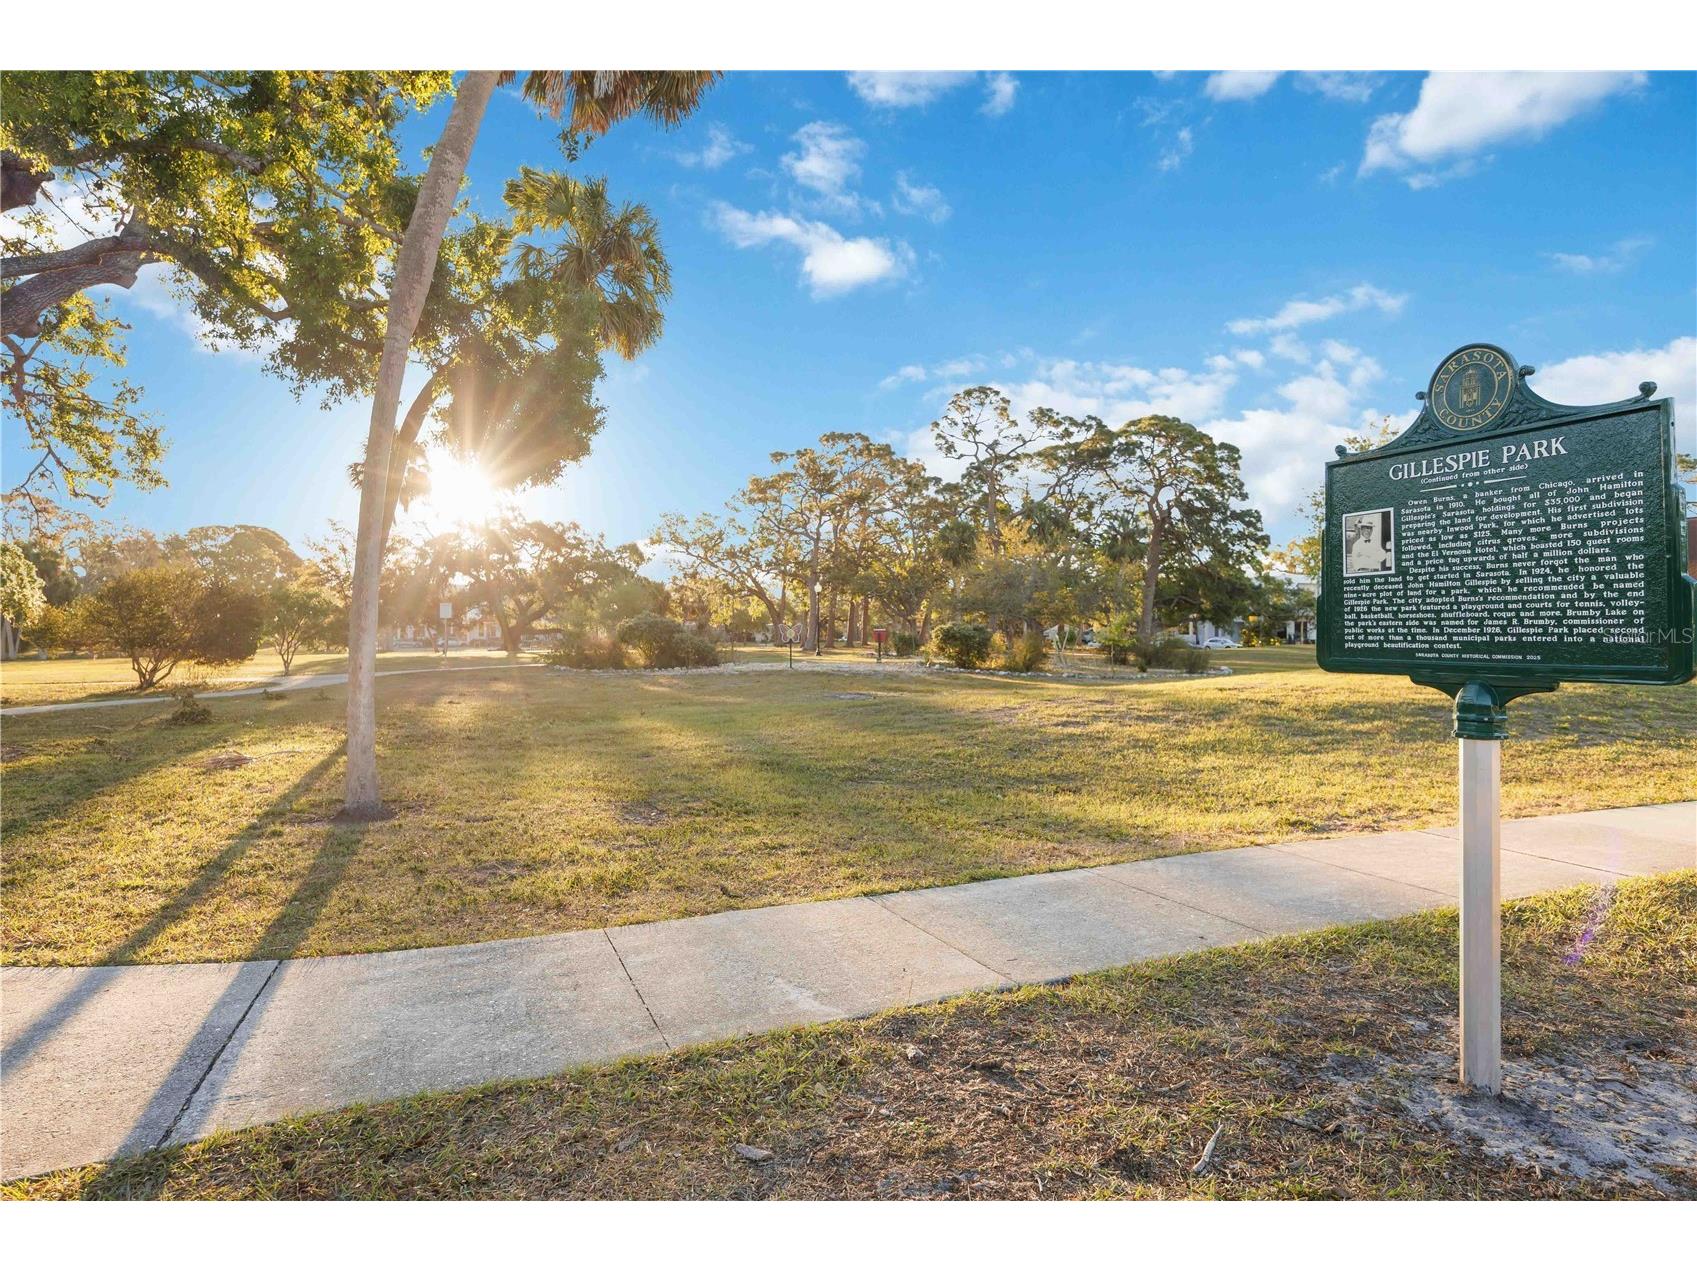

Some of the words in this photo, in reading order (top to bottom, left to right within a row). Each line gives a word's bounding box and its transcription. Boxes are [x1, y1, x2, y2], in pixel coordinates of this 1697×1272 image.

[1435, 351, 1506, 392] SARASOTA
[1439, 398, 1502, 428] COUNTY
[1389, 450, 1490, 480] GILLESPIE
[1502, 436, 1568, 463] PARK
[1421, 474, 1458, 484] (Continued
[1462, 470, 1480, 478] from
[1484, 468, 1505, 476] other
[1509, 463, 1528, 471] side)
[1586, 472, 1623, 483] arrived
[1400, 506, 1430, 514] Sarasota
[1493, 494, 1520, 503] bought
[1599, 480, 1643, 490] Hamilton
[1401, 512, 1435, 521] Gillespie's
[1442, 508, 1474, 516] Sarasota
[1614, 490, 1643, 498] began
[1401, 520, 1435, 530] preparing
[1592, 498, 1643, 509] subdivision
[1567, 509, 1615, 520] advertised
[1401, 536, 1424, 545] priced
[1600, 516, 1644, 527] projects
[1583, 526, 1643, 536] subdivisions
[1530, 540, 1562, 549] boasted
[1463, 554, 1495, 562] upwards
[1540, 558, 1567, 566] forgot
[1578, 563, 1616, 572] honored
[1523, 583, 1584, 591] recommended
[1460, 602, 1504, 610] playground
